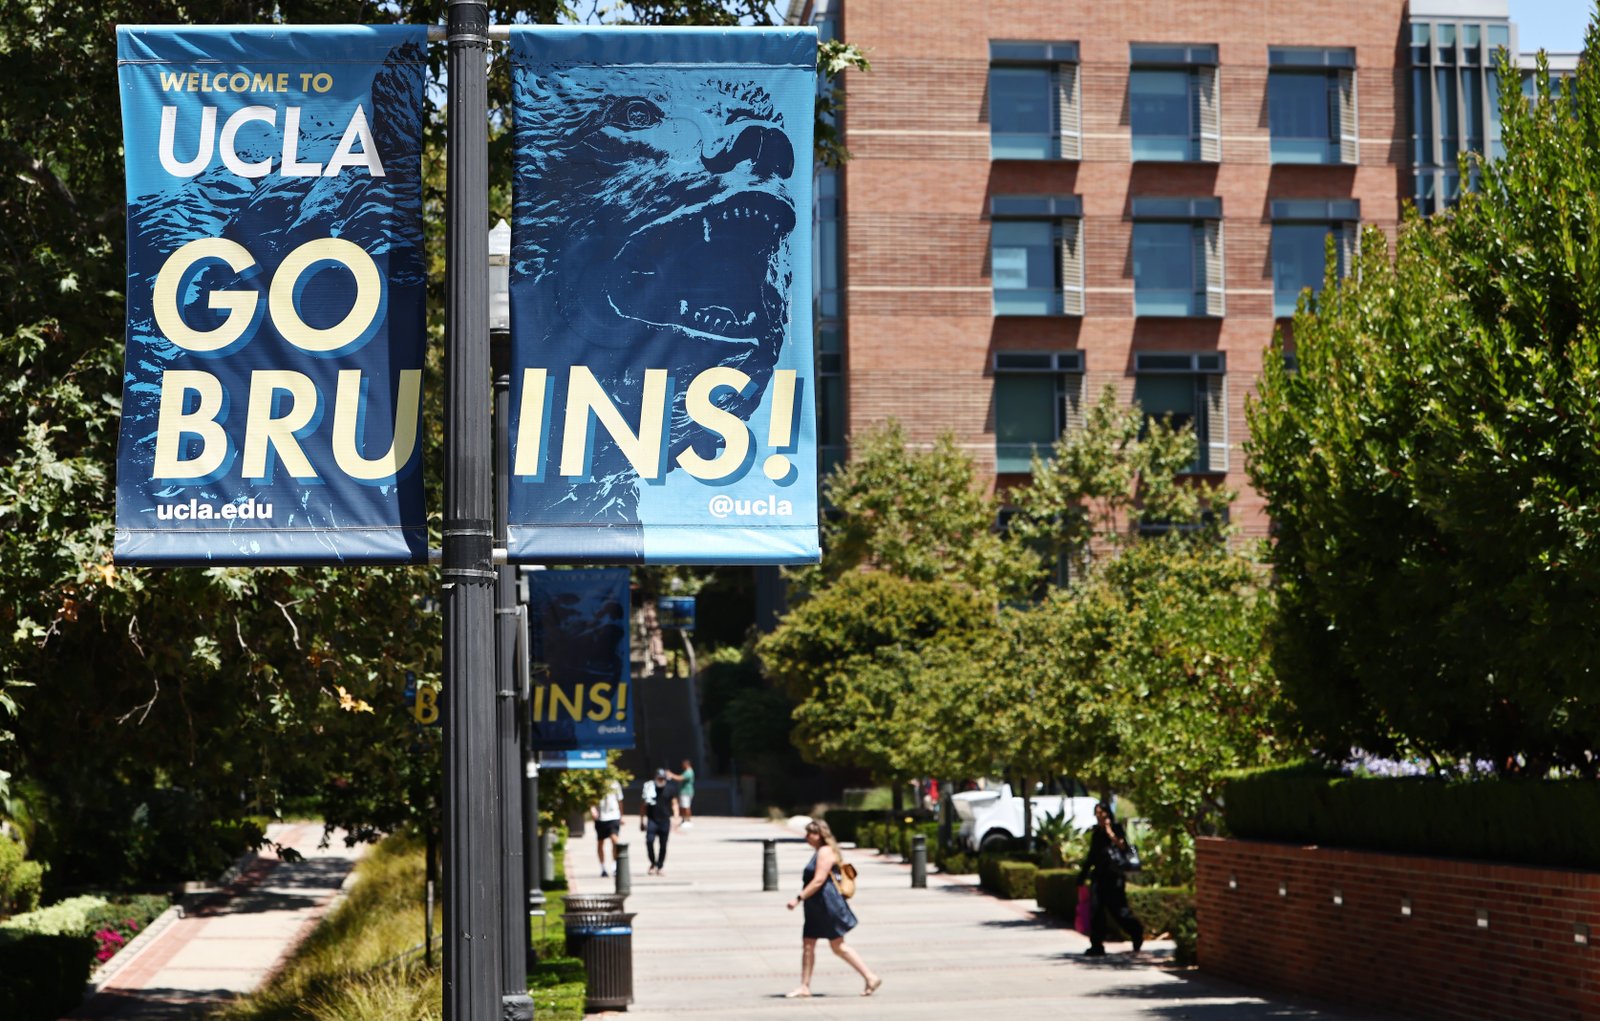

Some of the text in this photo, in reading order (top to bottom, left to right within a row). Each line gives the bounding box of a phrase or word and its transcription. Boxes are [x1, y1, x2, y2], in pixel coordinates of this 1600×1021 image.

[159, 72, 333, 93] WELCOME TO
[158, 103, 386, 178] UCLA
[152, 237, 382, 352] GO
[152, 368, 422, 480] BRU
[513, 365, 797, 481] INS!
[156, 498, 273, 520] ucla.edu
[708, 494, 793, 518] @ucla
[533, 682, 627, 722] INS!
